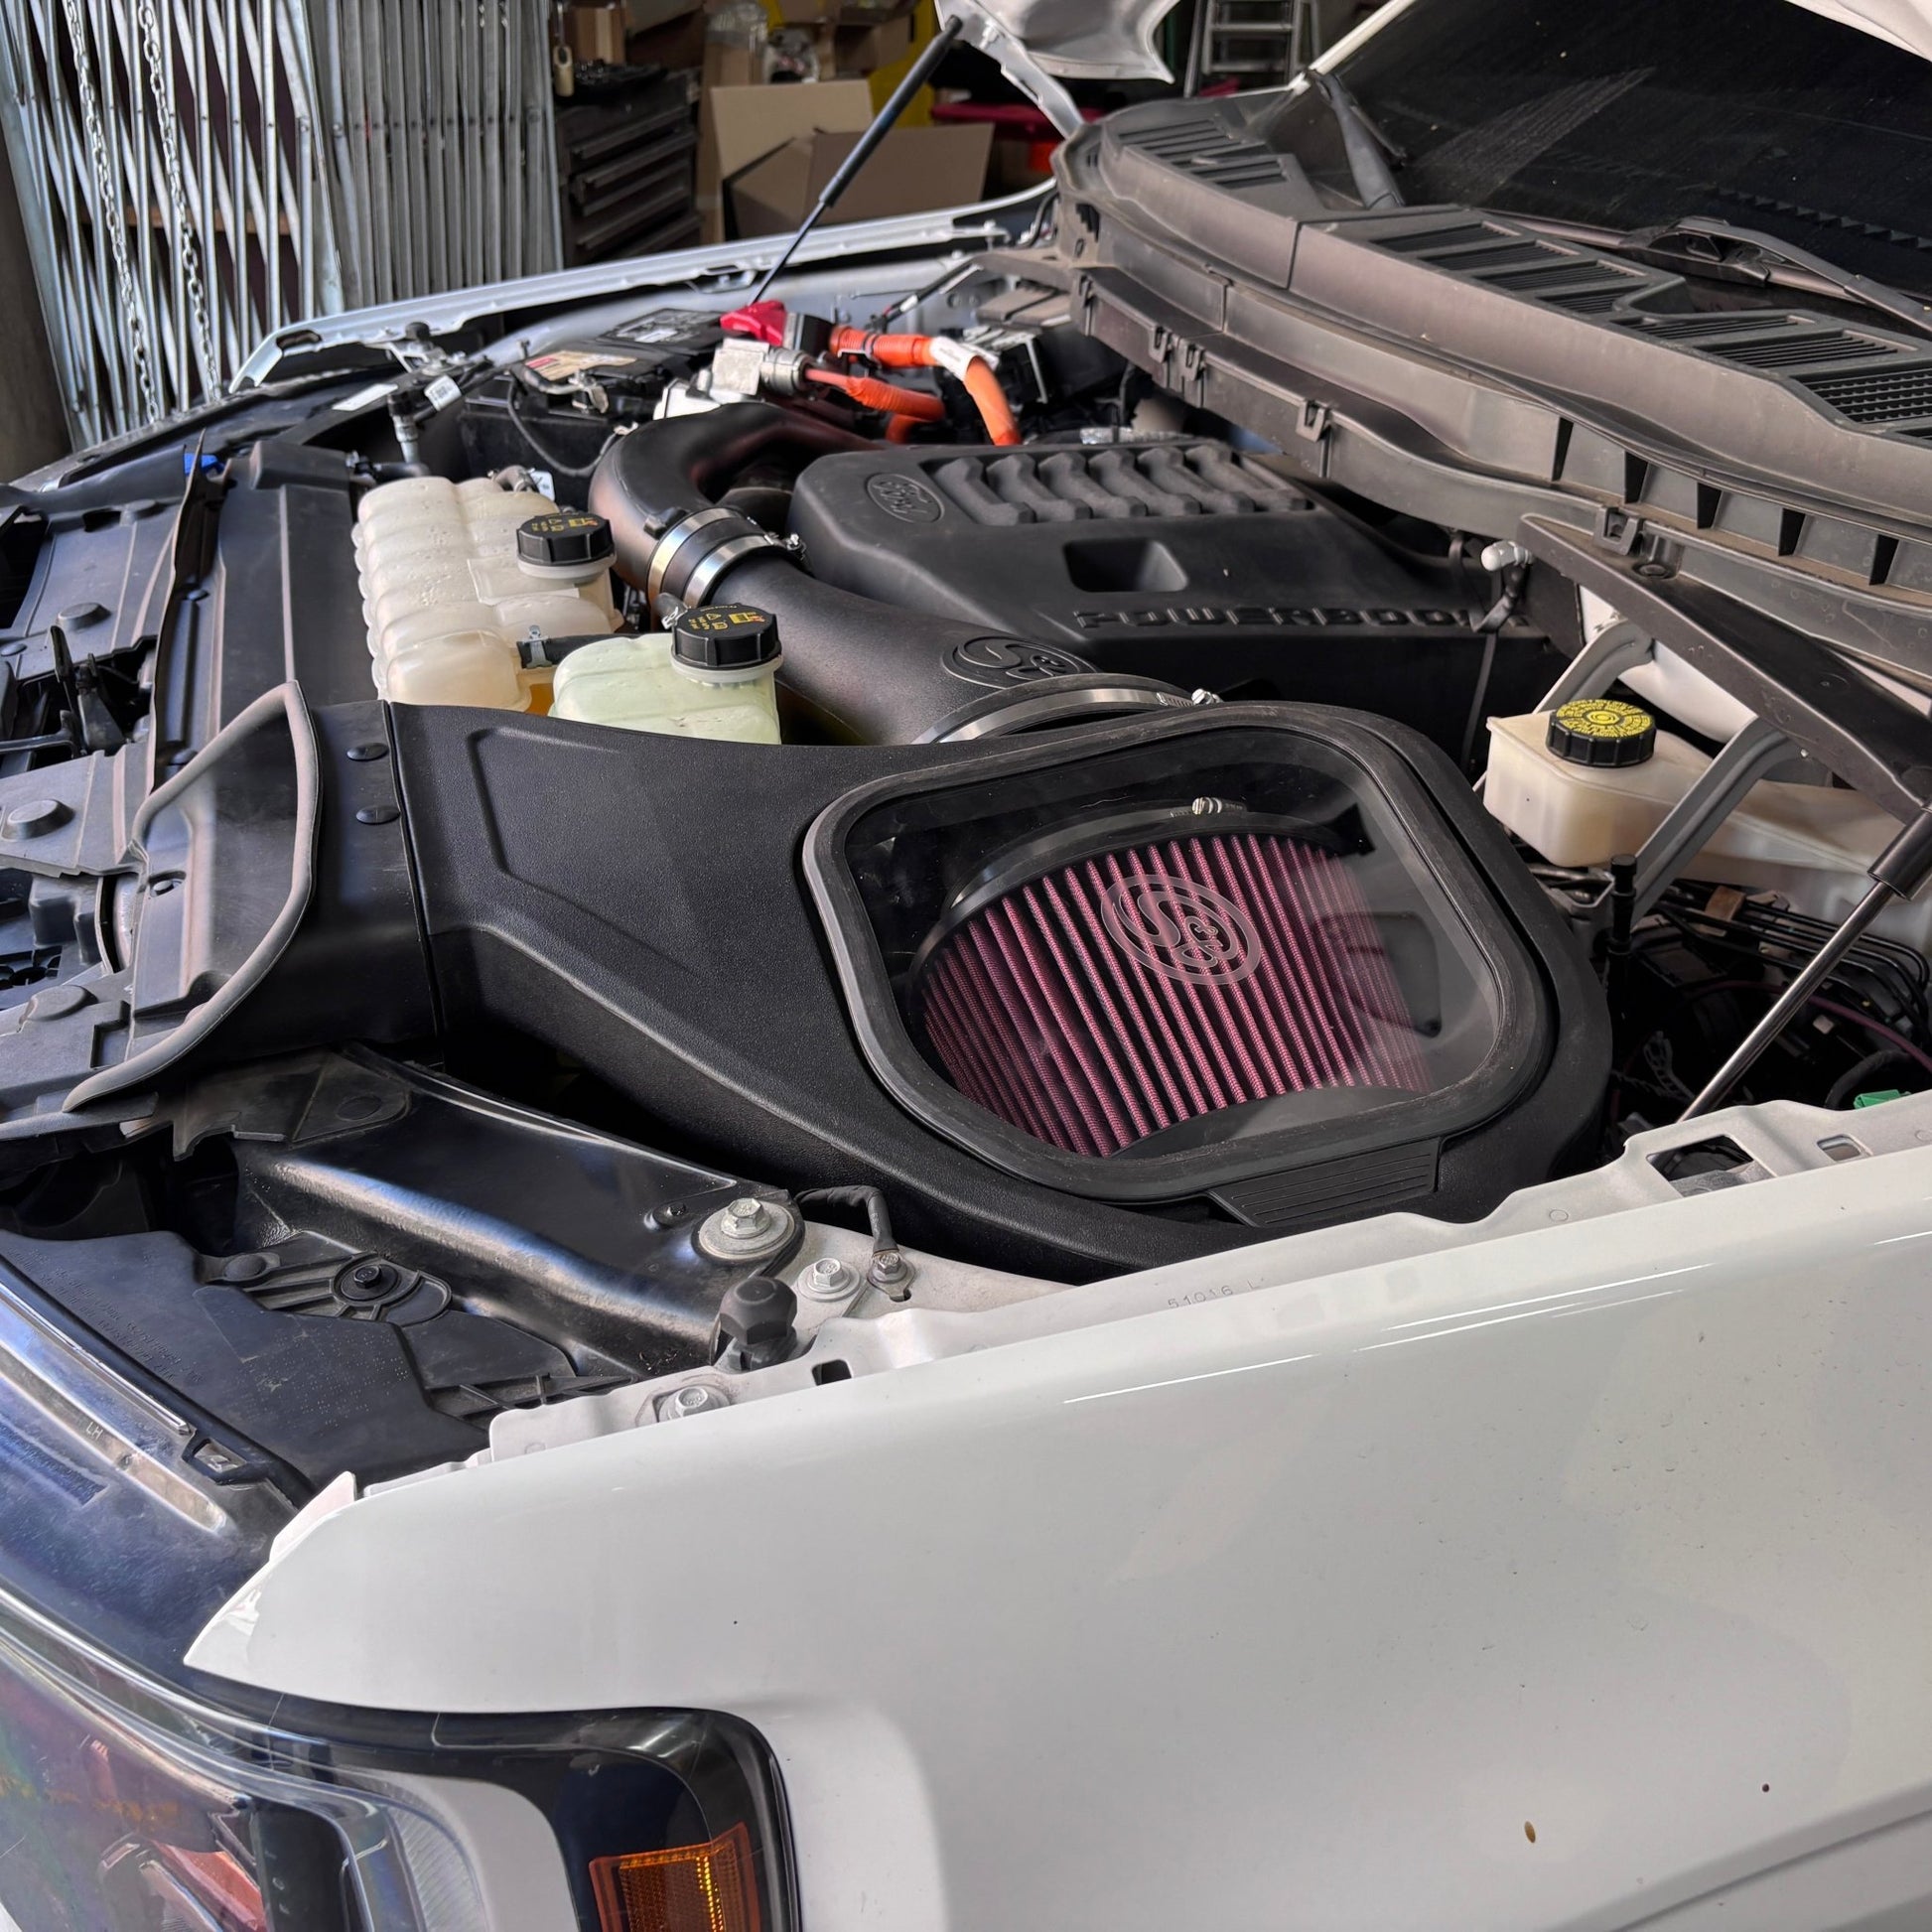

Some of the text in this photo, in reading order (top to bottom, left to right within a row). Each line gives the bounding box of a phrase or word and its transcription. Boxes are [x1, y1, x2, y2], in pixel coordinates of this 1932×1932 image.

[1072, 607, 1529, 628] POWERBOO
[1168, 1285, 1234, 1309] 51016
[85, 1421, 103, 1441] LH
